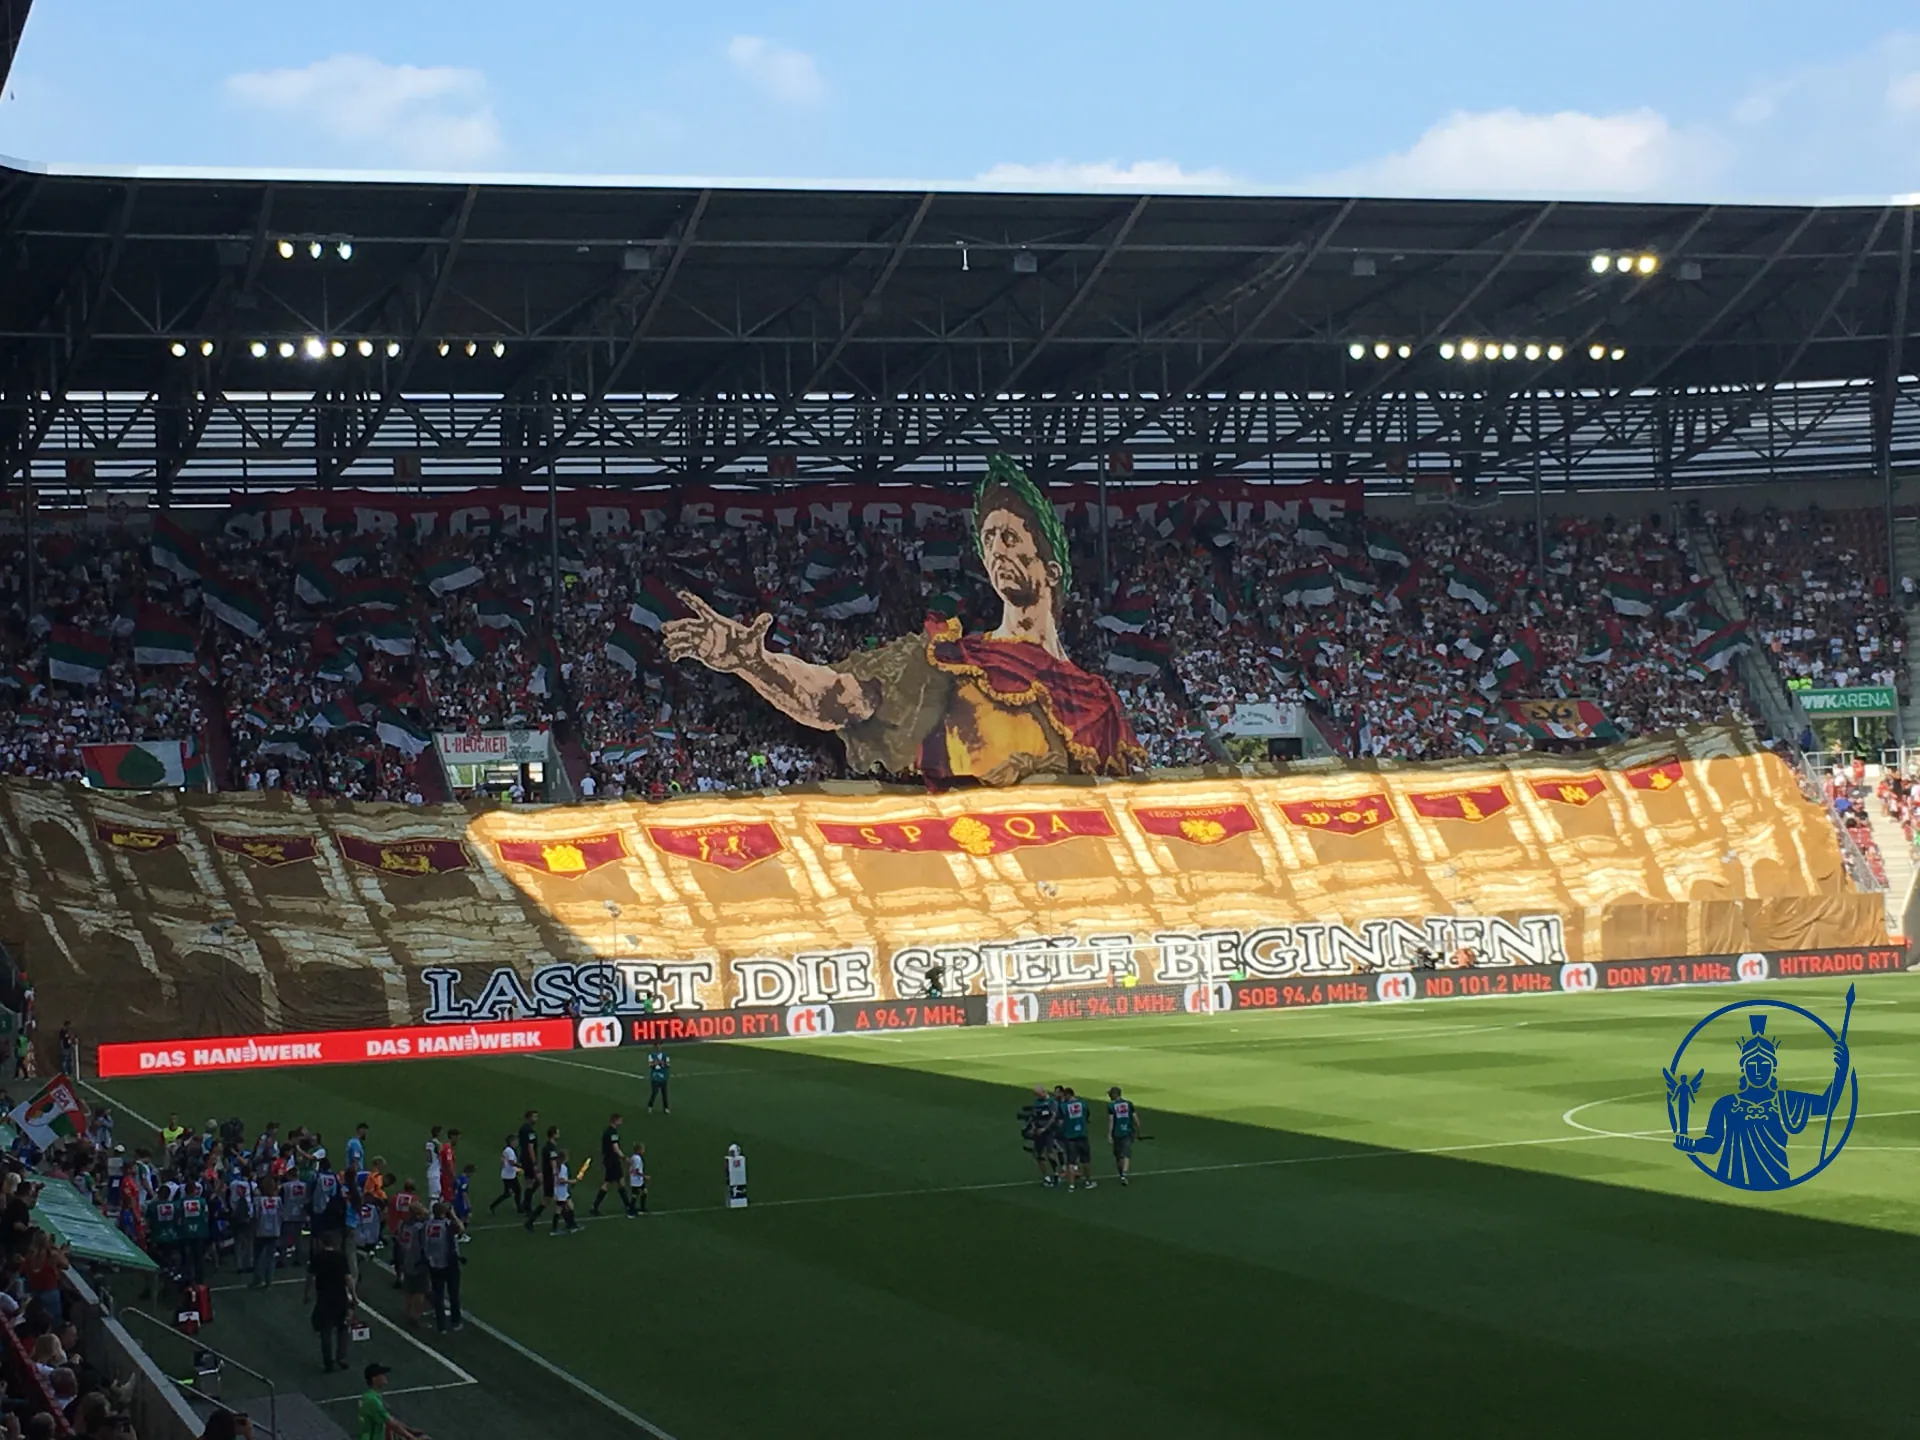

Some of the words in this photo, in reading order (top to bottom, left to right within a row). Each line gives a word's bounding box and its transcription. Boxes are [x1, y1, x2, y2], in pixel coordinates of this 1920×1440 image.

[423, 957, 715, 1023] LASSET
[730, 949, 876, 1008] DIE
[893, 936, 1140, 998] SPIELE
[1154, 915, 1568, 984] BEGINNEN!
[633, 1016, 736, 1041] HITRADIO
[741, 1013, 780, 1034] RT1
[855, 1011, 871, 1029] A
[874, 1007, 918, 1027] 96.7
[923, 1005, 967, 1025] MHz
[1238, 987, 1278, 1008] SOB
[1283, 985, 1322, 1005] 94.6
[1327, 982, 1368, 1003] MHz
[1426, 977, 1453, 996] ND
[1459, 974, 1508, 995] 101.2
[1513, 972, 1552, 992] MHz
[1607, 967, 1646, 987] DON
[1650, 964, 1687, 984] 97.1
[1692, 962, 1732, 982] MHz
[1779, 952, 1863, 975] HITRADIO
[1868, 950, 1901, 969] RT1
[140, 1050, 186, 1070] DAS
[366, 1038, 411, 1057] DAS
